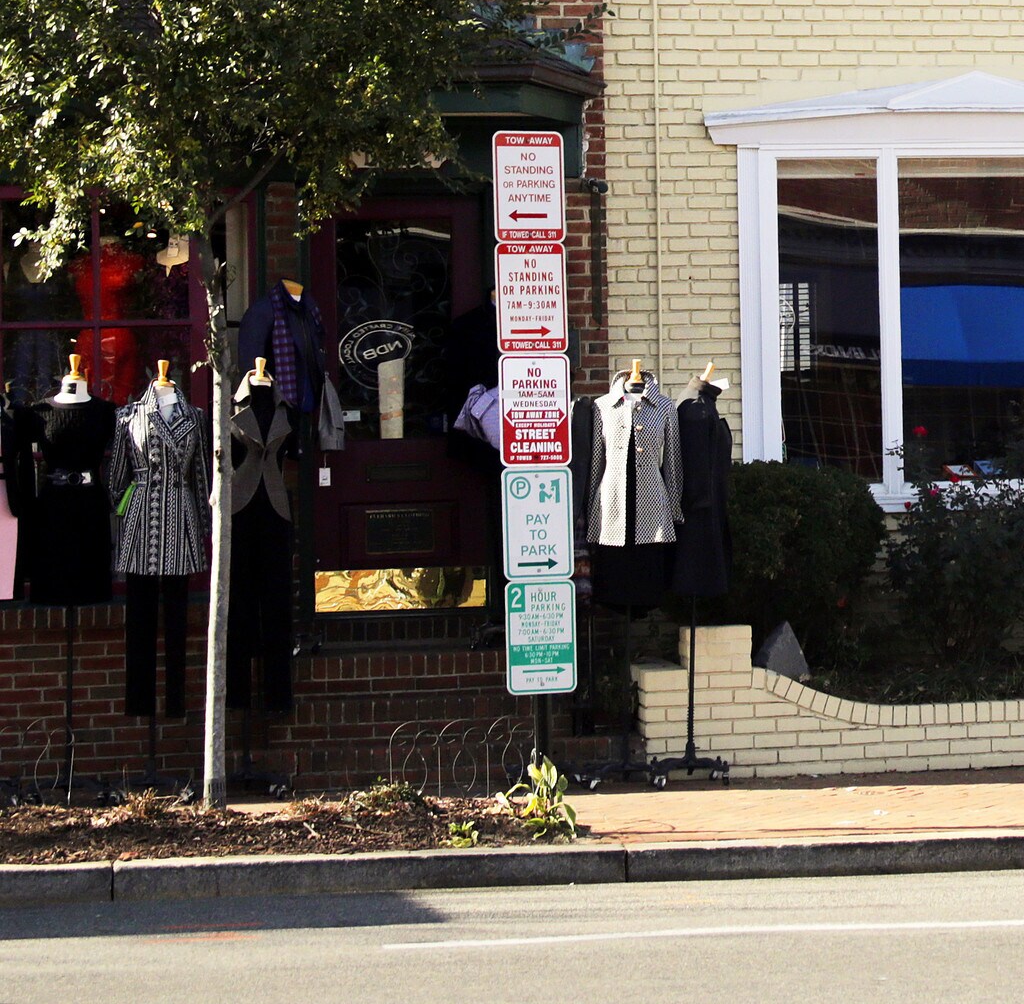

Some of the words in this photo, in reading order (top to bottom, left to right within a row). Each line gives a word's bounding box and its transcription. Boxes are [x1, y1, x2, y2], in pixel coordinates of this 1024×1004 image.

[505, 136, 525, 145] TOW
[529, 136, 553, 145] AWAY
[520, 152, 536, 161] NO
[504, 166, 554, 175] STANDING
[503, 181, 514, 189] OR
[516, 180, 556, 189] PARKING
[507, 194, 552, 203] ANYTIME
[506, 245, 526, 253] TOW
[529, 245, 554, 253] AWAY
[524, 259, 537, 269] NO
[508, 271, 554, 282] STANDING
[503, 285, 515, 295] OR
[520, 285, 560, 295] PARKING
[504, 341, 510, 349] IF
[512, 341, 532, 349] TOWED
[534, 341, 550, 349] CALL
[527, 367, 542, 378] NO
[512, 379, 557, 389] PARKING
[512, 400, 558, 408] WEDNESDAY
[511, 411, 525, 419] TOW
[526, 411, 543, 419] AWAY
[544, 411, 560, 419] ZONE
[515, 428, 557, 440] STREET
[510, 442, 562, 454] CLEANING
[525, 513, 550, 525] PAY
[529, 529, 548, 540] TO
[521, 544, 557, 556] PARK
[510, 587, 522, 609] 2
[530, 591, 557, 603] HOUR
[530, 602, 566, 612] PARKING
